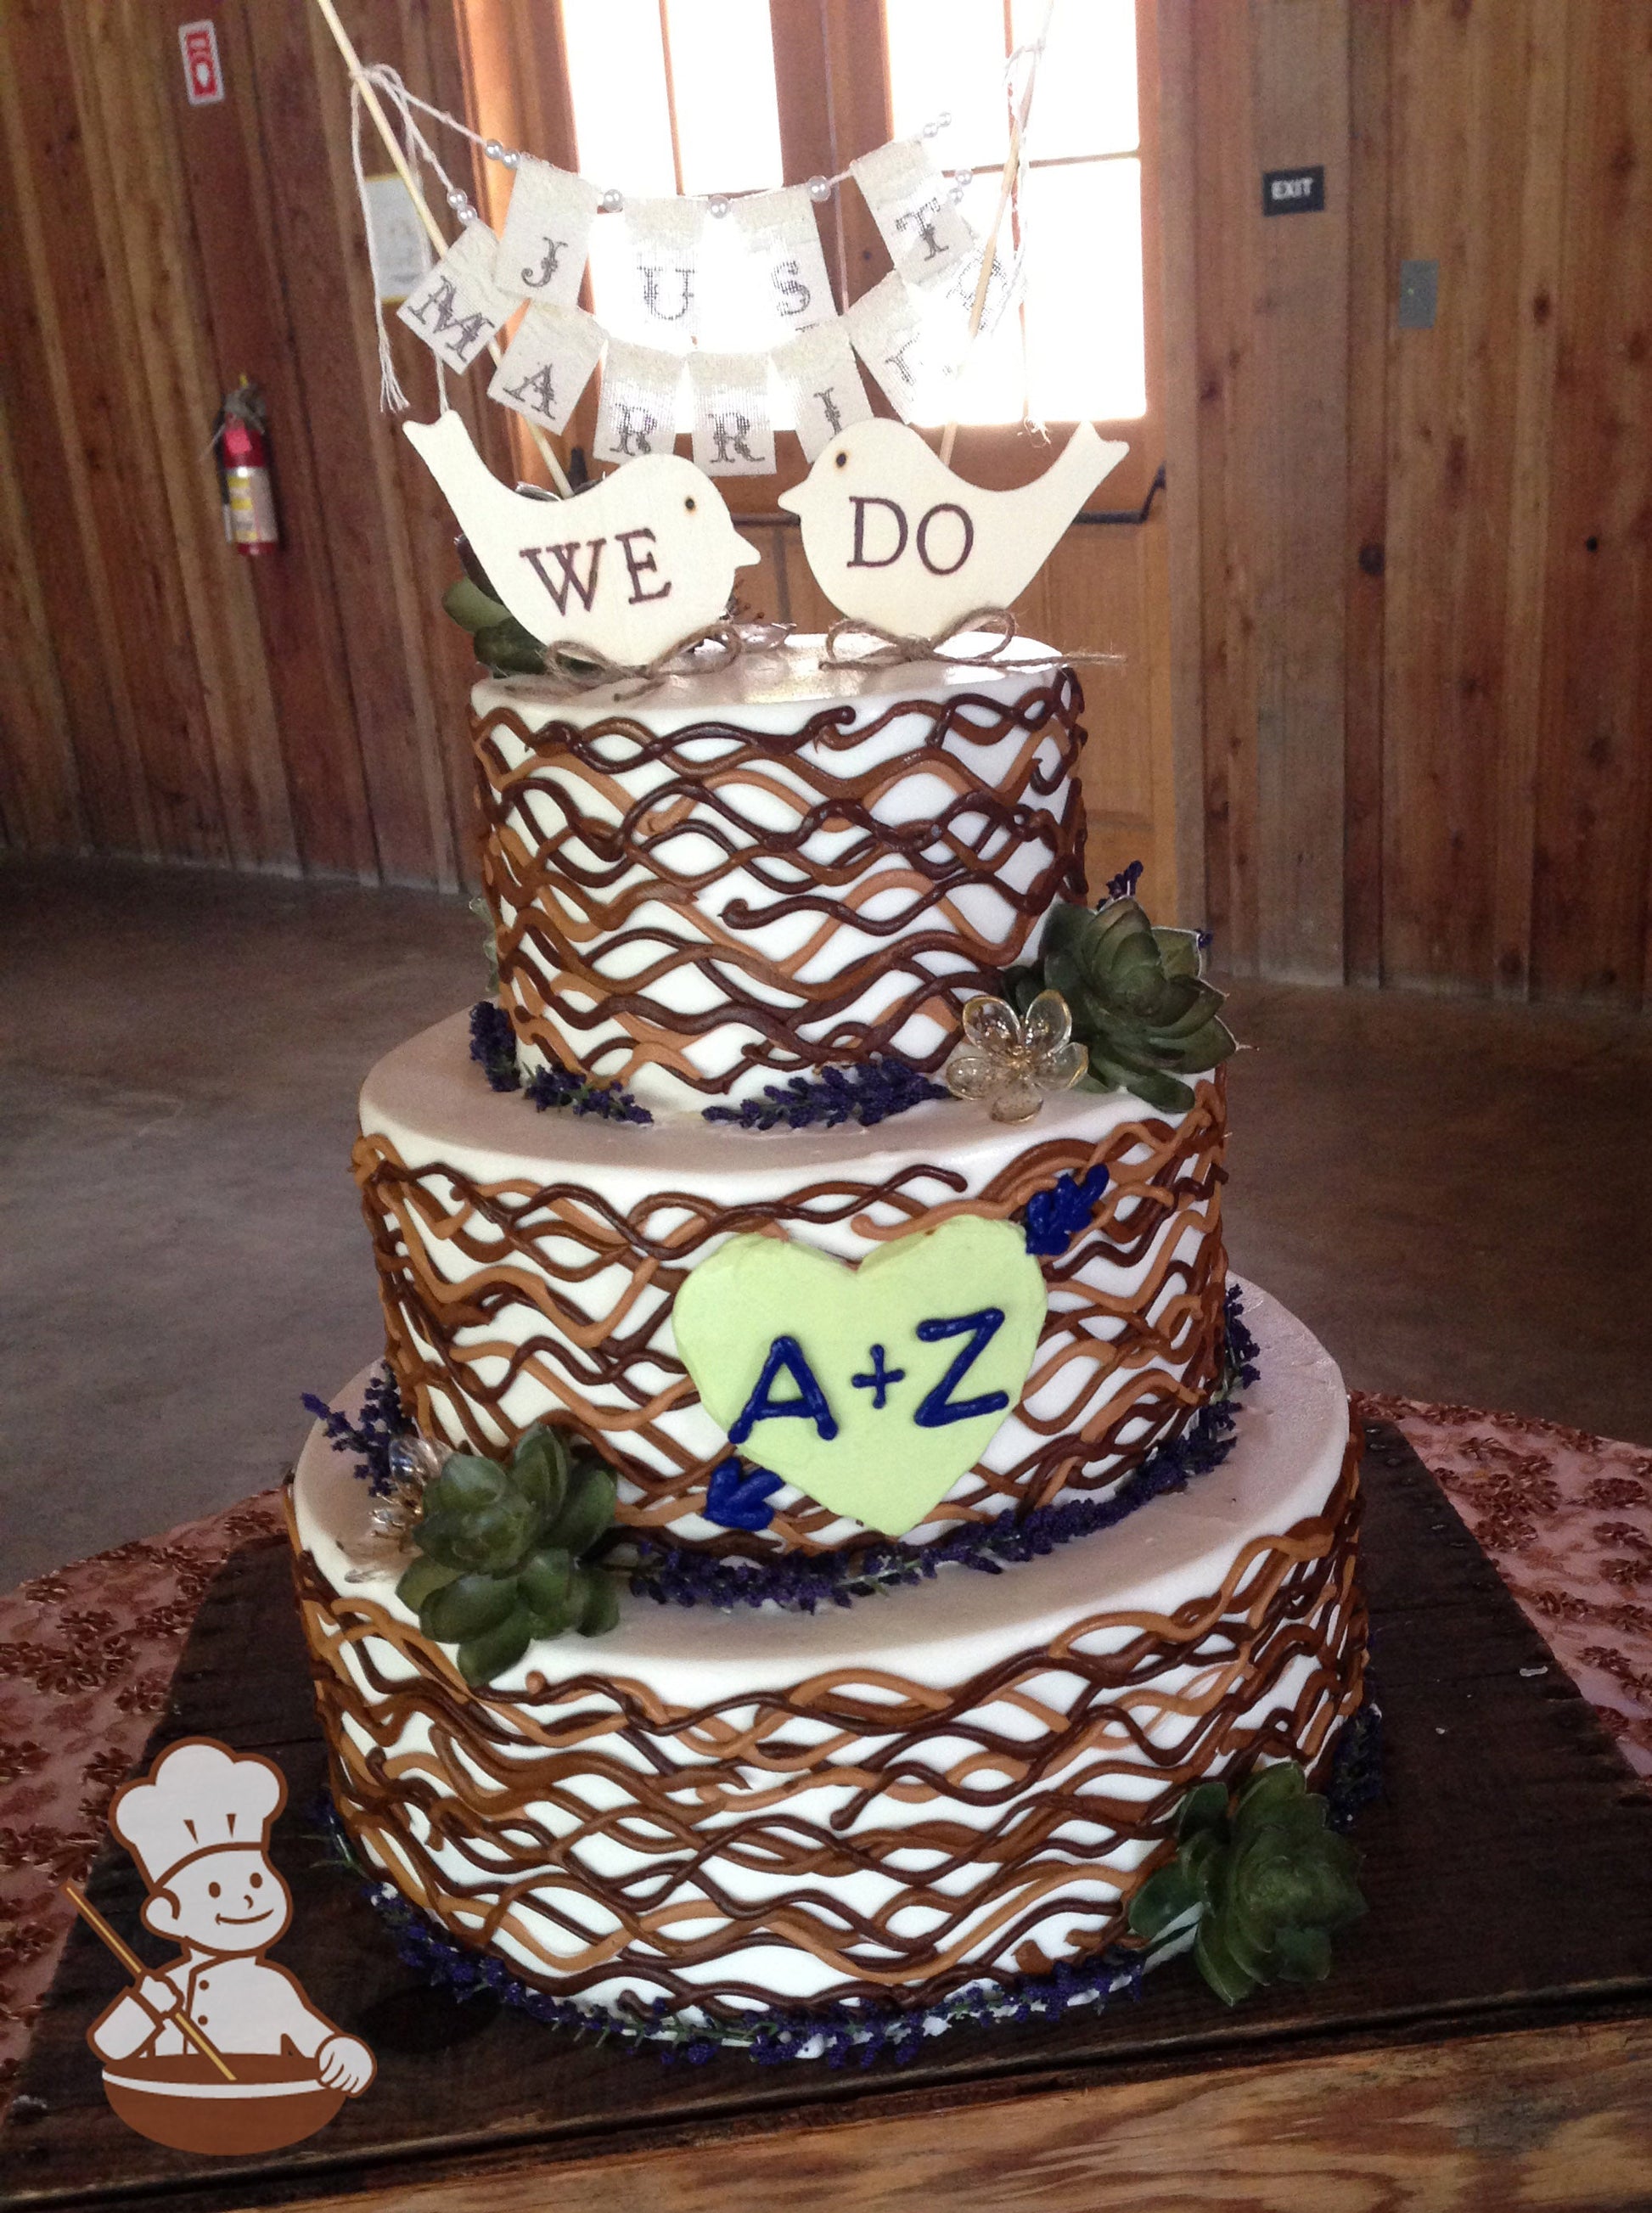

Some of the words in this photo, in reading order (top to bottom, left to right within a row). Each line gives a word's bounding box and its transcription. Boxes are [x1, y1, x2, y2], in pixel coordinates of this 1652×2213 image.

[1270, 177, 1314, 200] EXIT
[520, 197, 950, 322] JUST
[407, 251, 1009, 464] MARRID
[519, 527, 673, 616] WE
[846, 495, 975, 576] DO
